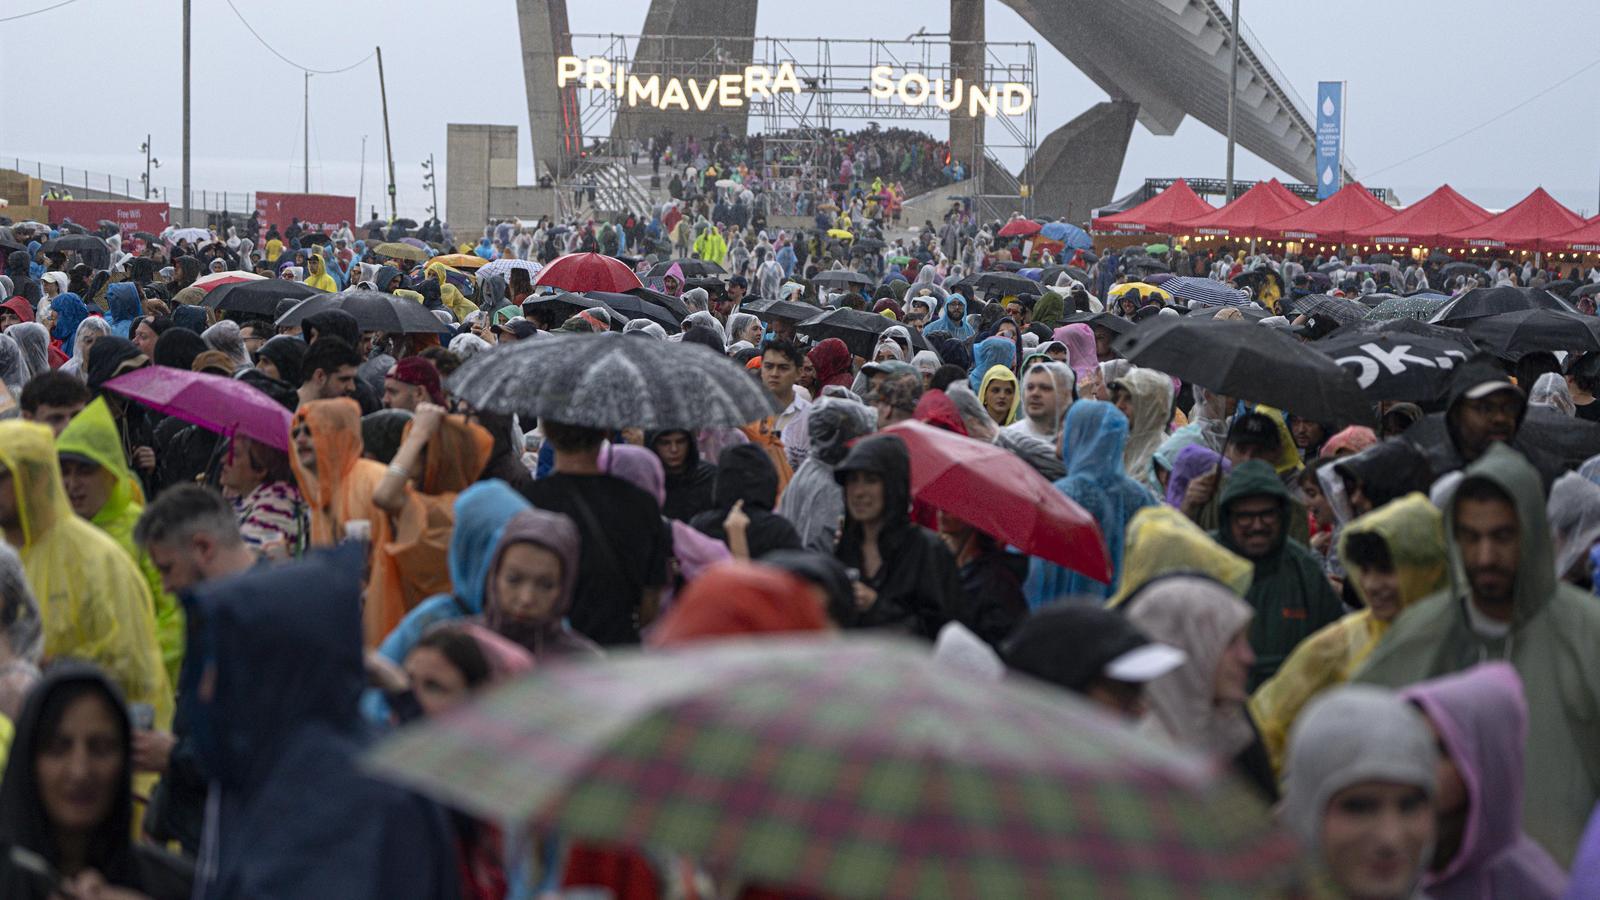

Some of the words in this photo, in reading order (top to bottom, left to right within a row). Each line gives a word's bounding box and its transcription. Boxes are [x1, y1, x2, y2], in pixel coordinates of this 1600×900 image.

[557, 56, 801, 110] PRIMAVERA
[871, 66, 1032, 117] SOUND
[306, 221, 339, 231] Occdent
